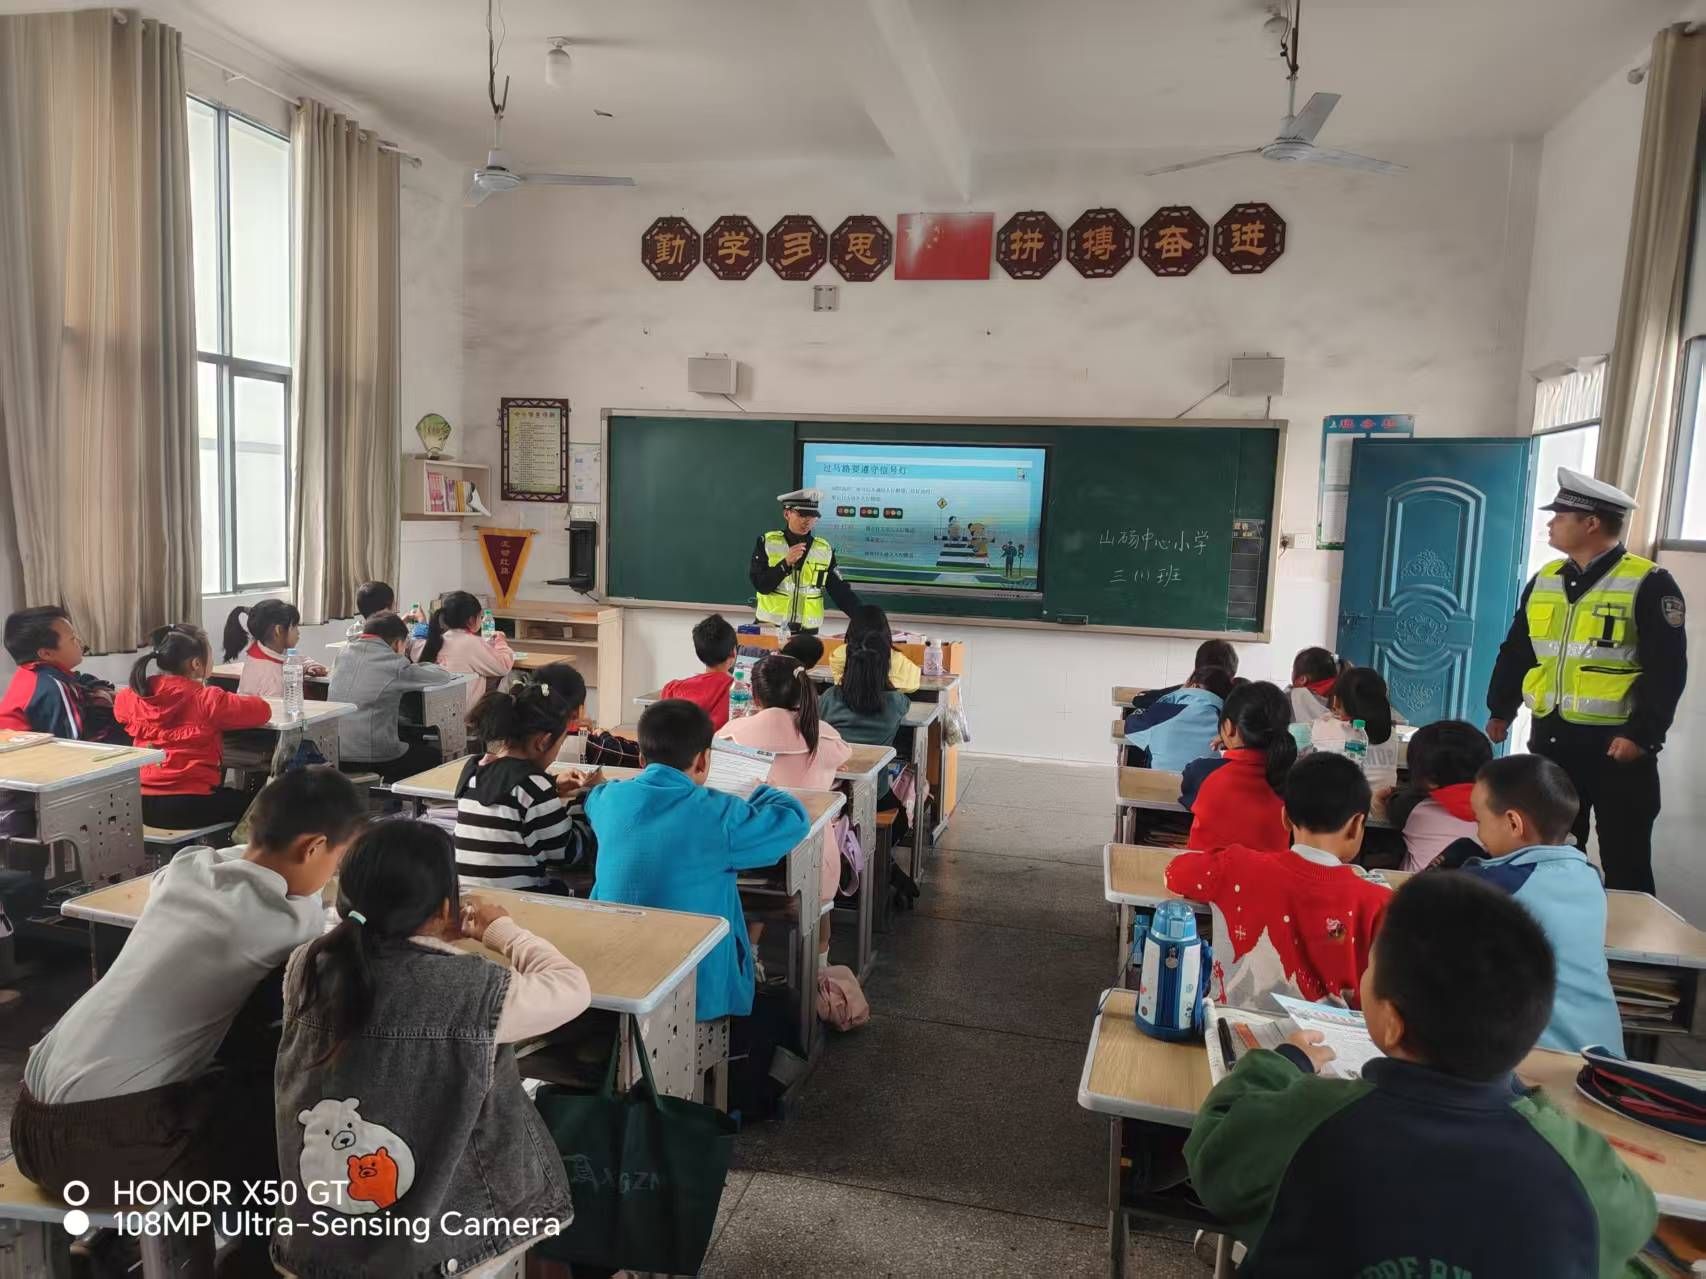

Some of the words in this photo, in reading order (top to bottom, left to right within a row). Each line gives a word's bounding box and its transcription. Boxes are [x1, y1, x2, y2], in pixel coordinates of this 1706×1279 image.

[654, 231, 878, 266] 勤学多思
[1009, 220, 1267, 263] 拼搏奋进
